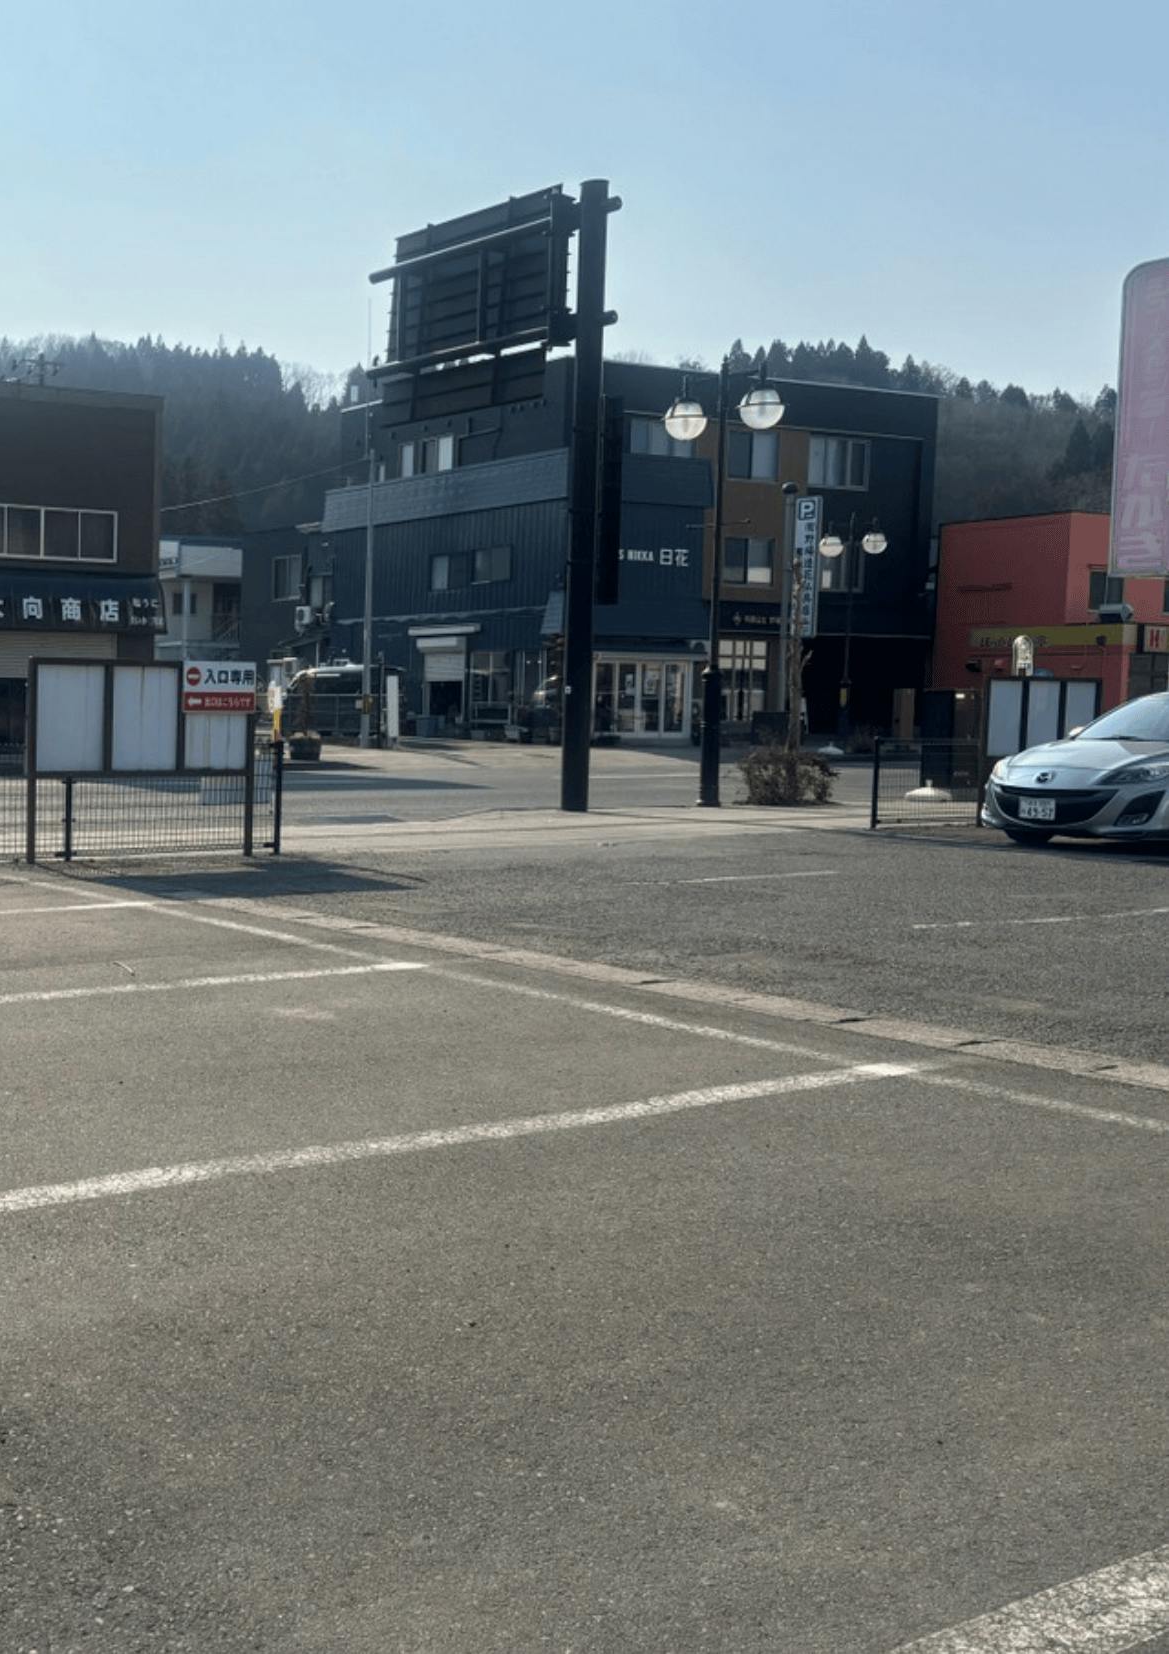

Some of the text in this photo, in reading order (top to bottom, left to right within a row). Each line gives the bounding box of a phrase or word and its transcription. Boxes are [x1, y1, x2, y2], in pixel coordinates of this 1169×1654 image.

[660, 548, 689, 567] 日花
[204, 668, 254, 685] 入口専用
[204, 696, 251, 708] 出口はこちらです
